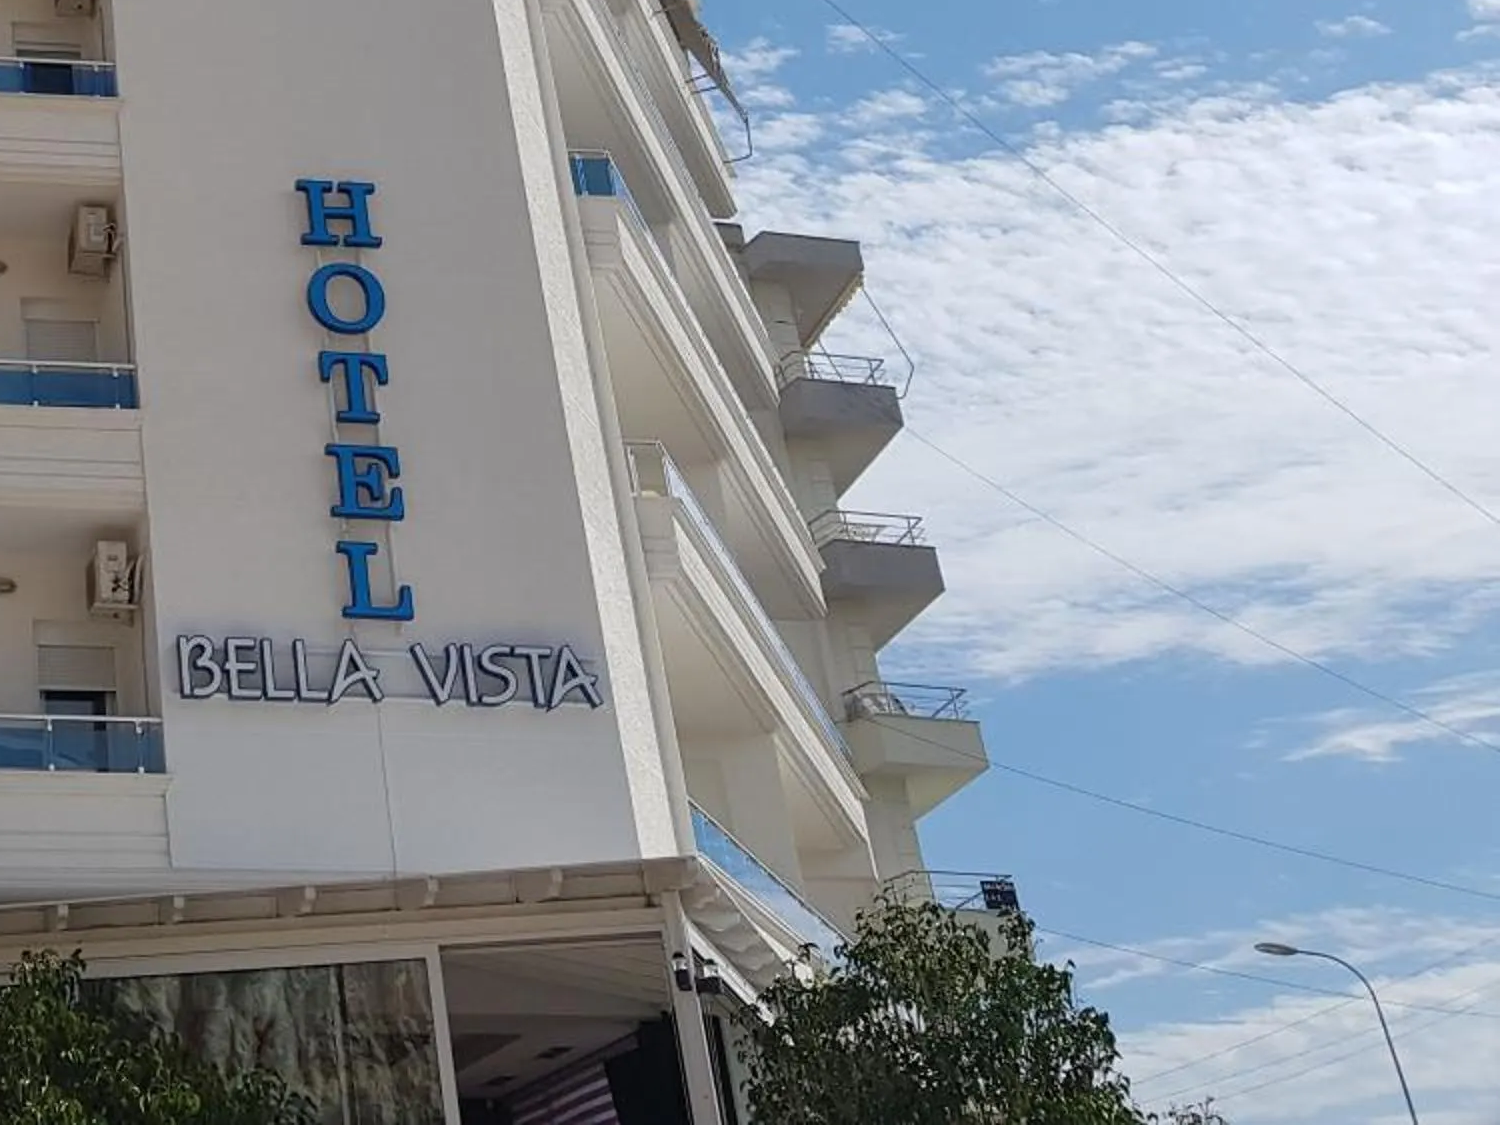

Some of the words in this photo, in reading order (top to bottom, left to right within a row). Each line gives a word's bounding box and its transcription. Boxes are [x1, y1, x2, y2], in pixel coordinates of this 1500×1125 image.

[295, 178, 414, 621] HOTEL
[176, 635, 384, 705] BELLA
[410, 641, 603, 711] VISTA
